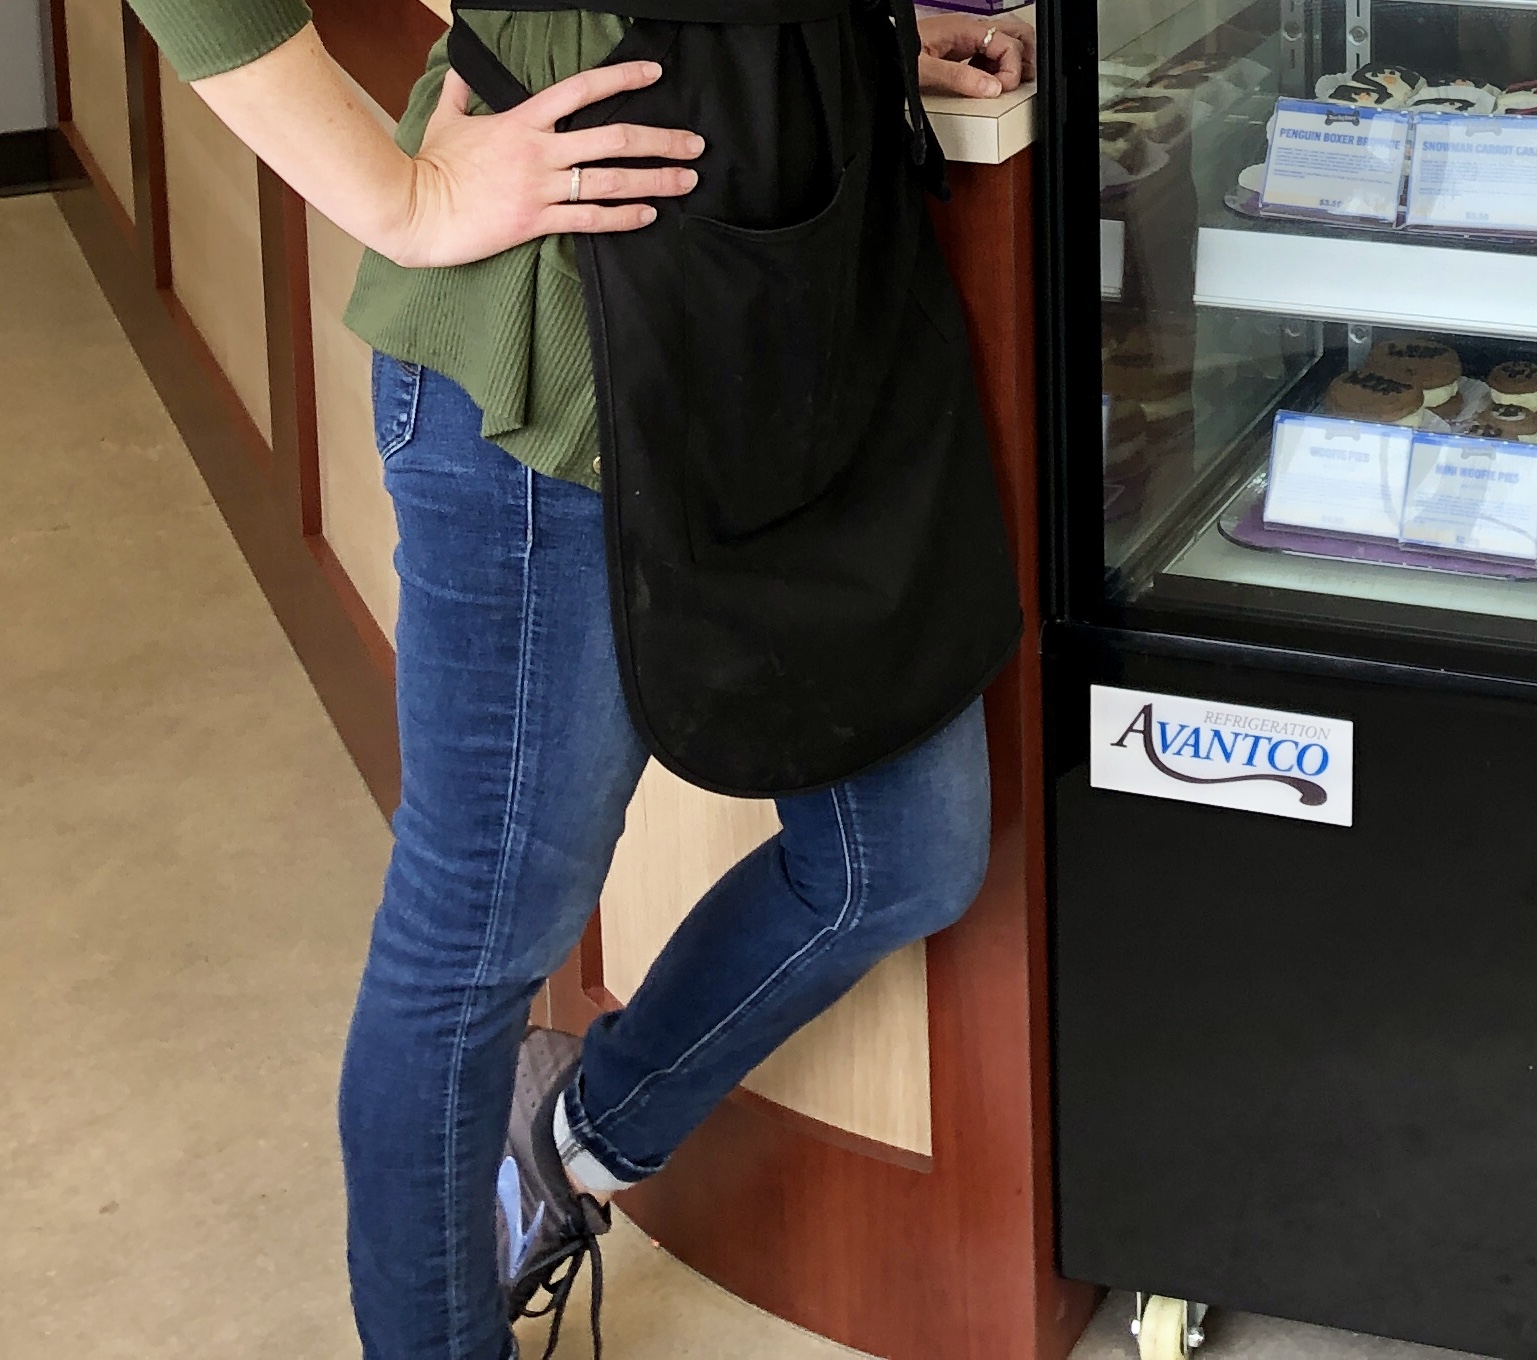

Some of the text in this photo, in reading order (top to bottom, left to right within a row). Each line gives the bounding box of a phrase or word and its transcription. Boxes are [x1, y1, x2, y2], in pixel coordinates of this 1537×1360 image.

[1280, 128, 1355, 145] PENGUIN BOXER
[1203, 711, 1332, 740] REFRIGERATION
[1110, 703, 1330, 782] AVANTCO
